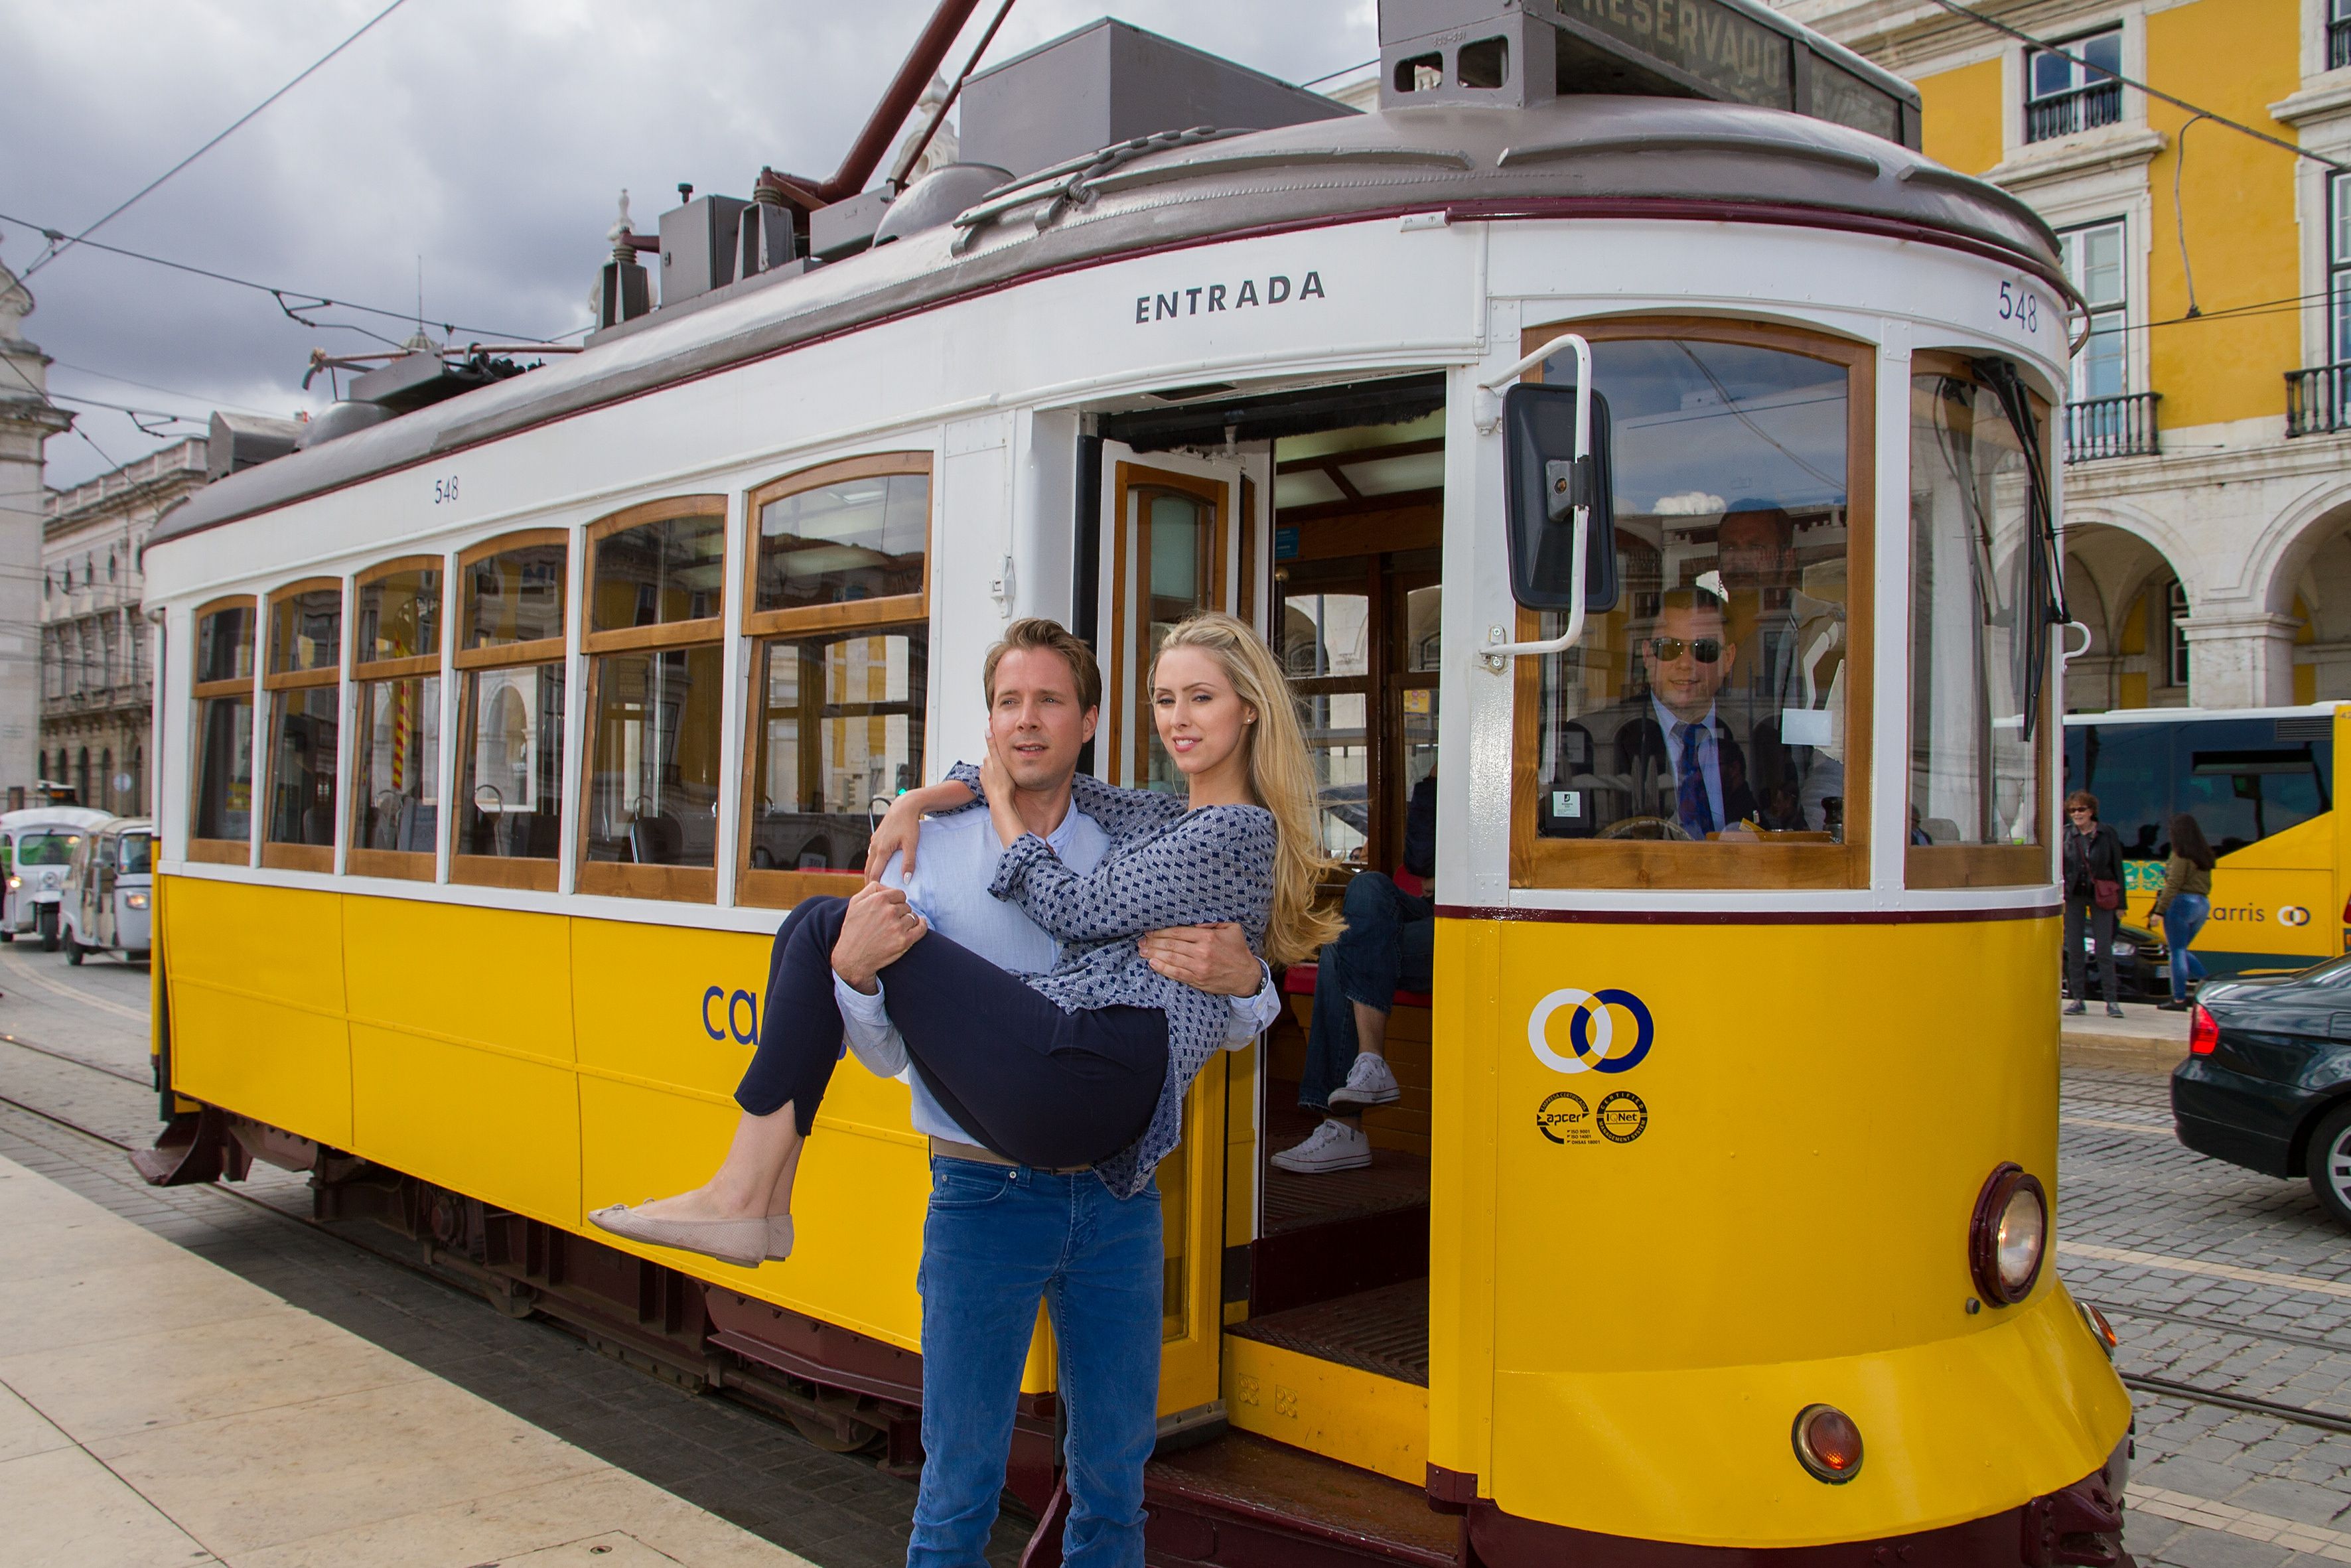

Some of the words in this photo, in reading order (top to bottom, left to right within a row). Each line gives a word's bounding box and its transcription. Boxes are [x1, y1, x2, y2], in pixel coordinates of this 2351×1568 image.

[1135, 271, 1326, 324] ENTRADA
[1999, 280, 2037, 333] 548
[435, 475, 459, 504] 548
[2206, 902, 2265, 922] arris
[1541, 1093, 1560, 1111] EMPRESA
[1600, 1092, 1644, 1110] CERTIFIED
[1546, 1113, 1581, 1126] apcer
[1606, 1112, 1638, 1124] IQNet
[1598, 1120, 1630, 1143] MANAGEMENT
[1631, 1119, 1646, 1139] SYSTEM
